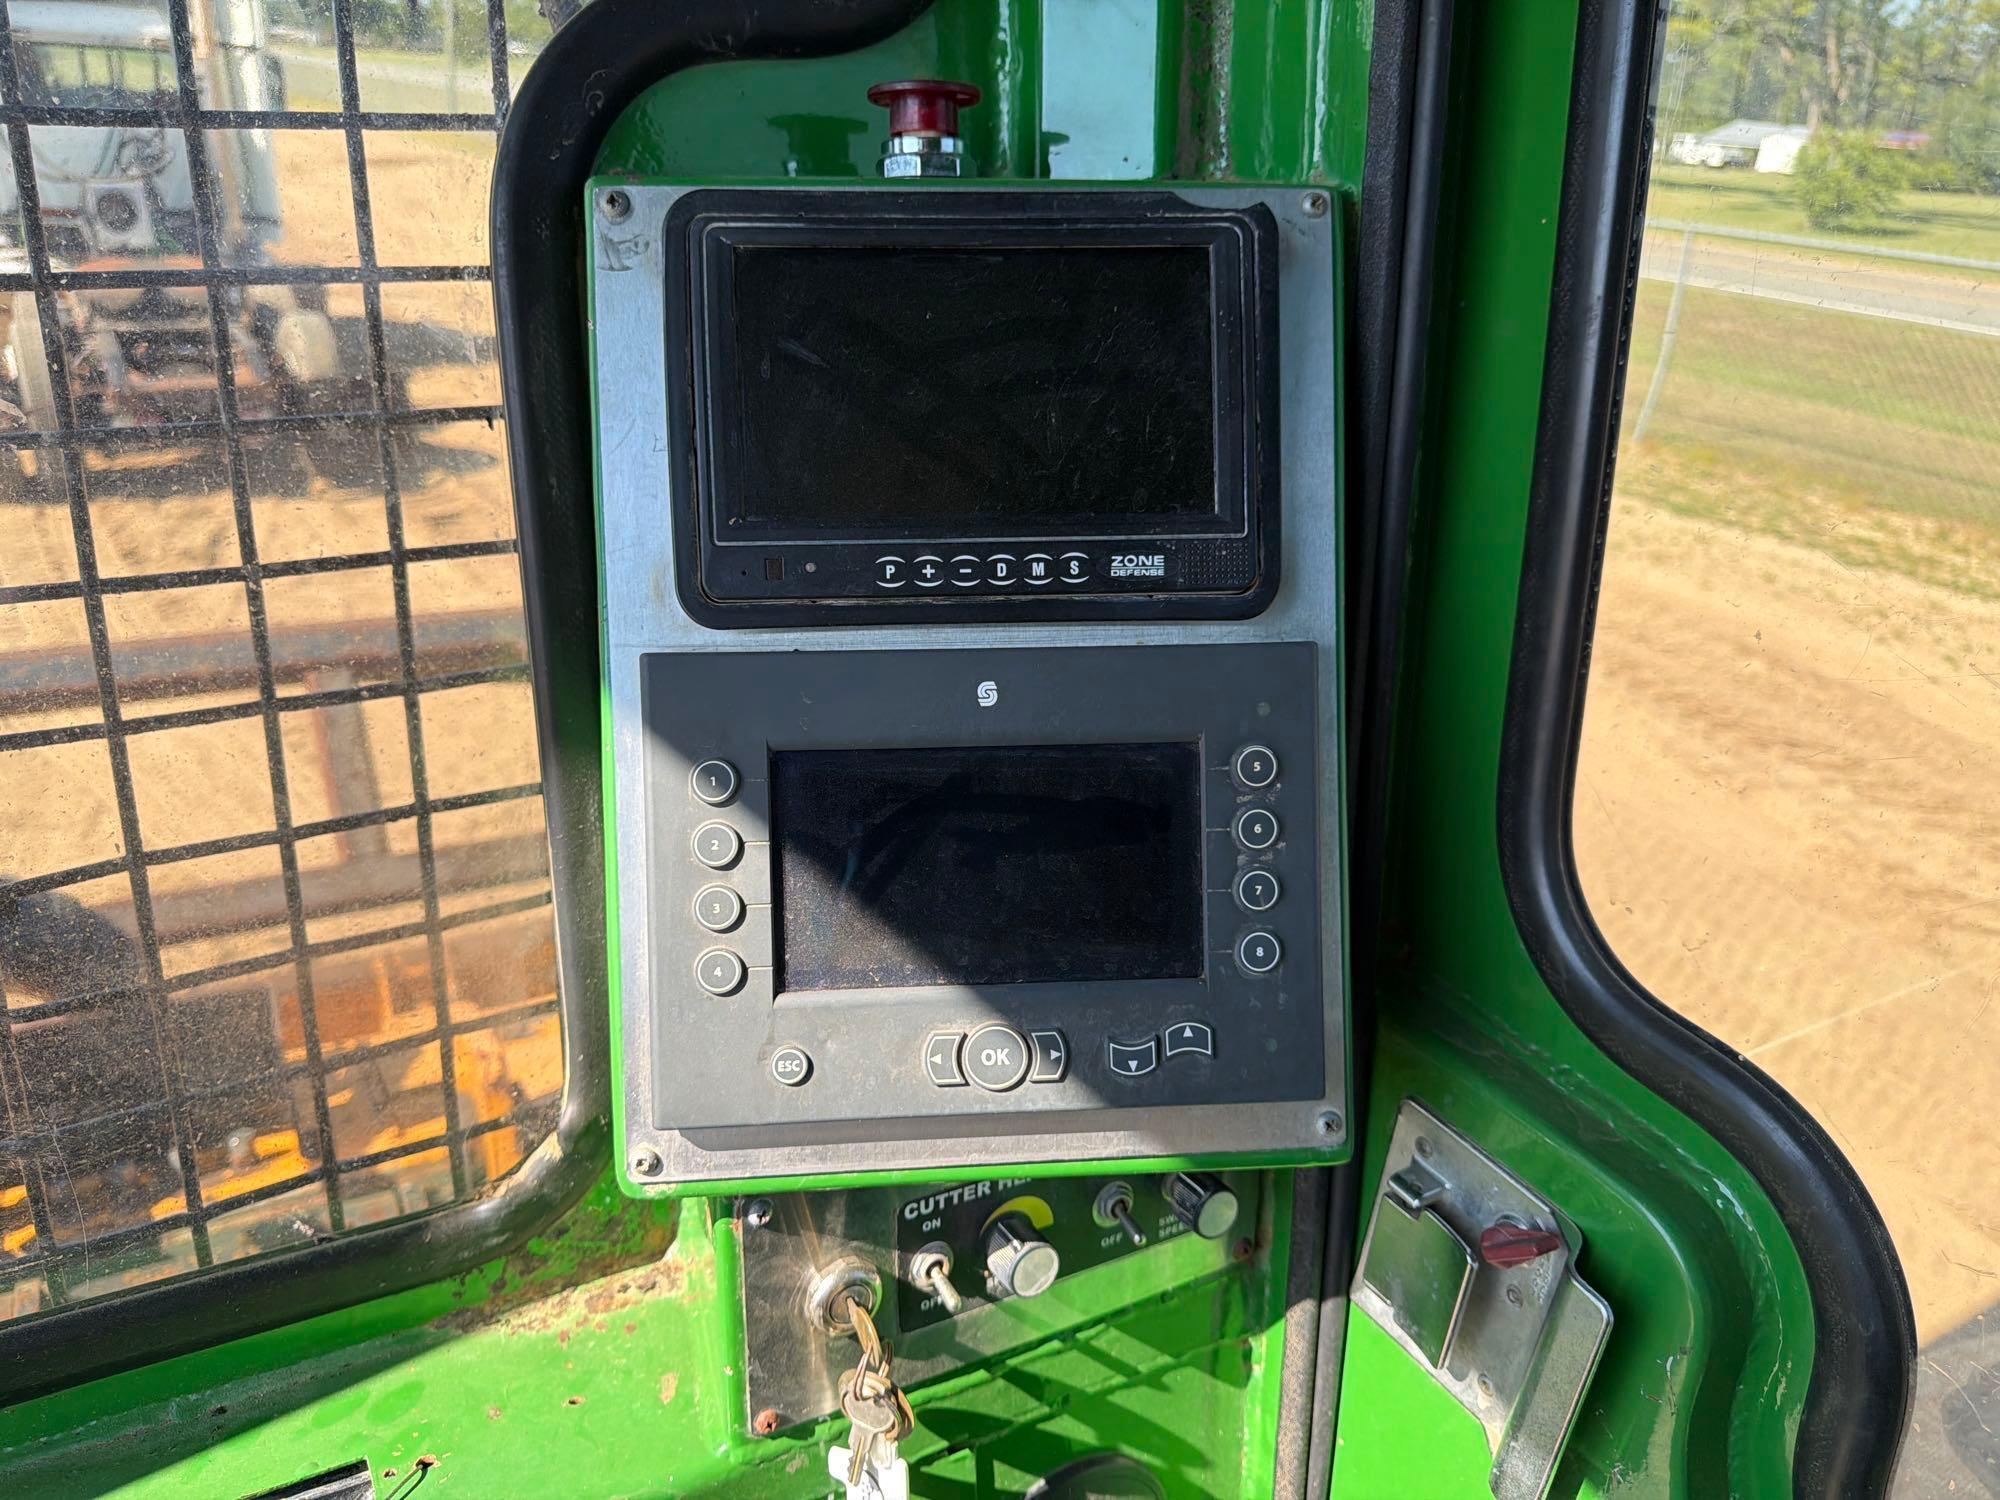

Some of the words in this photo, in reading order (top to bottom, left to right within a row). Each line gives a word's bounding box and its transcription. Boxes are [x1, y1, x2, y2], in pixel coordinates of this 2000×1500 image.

[1111, 554, 1165, 567] ZONE
[885, 562, 896, 579] P
[997, 562, 1007, 577] D
[1032, 562, 1045, 576] M
[1070, 560, 1079, 575] S
[1110, 567, 1165, 577] DEFENSE
[1253, 761, 1261, 772] 5
[709, 776, 716, 786] 1
[1253, 823, 1262, 834] 6
[711, 840, 720, 850] 2
[1254, 885, 1263, 896] 7
[713, 904, 721, 914] 3
[1255, 946, 1264, 957] 8
[713, 966, 722, 977] 4
[980, 1048, 1010, 1067] OK
[777, 1059, 800, 1073] ESC
[903, 1180, 991, 1220] CUTTER
[922, 1217, 941, 1232] ON
[1100, 1231, 1123, 1248] OFF
